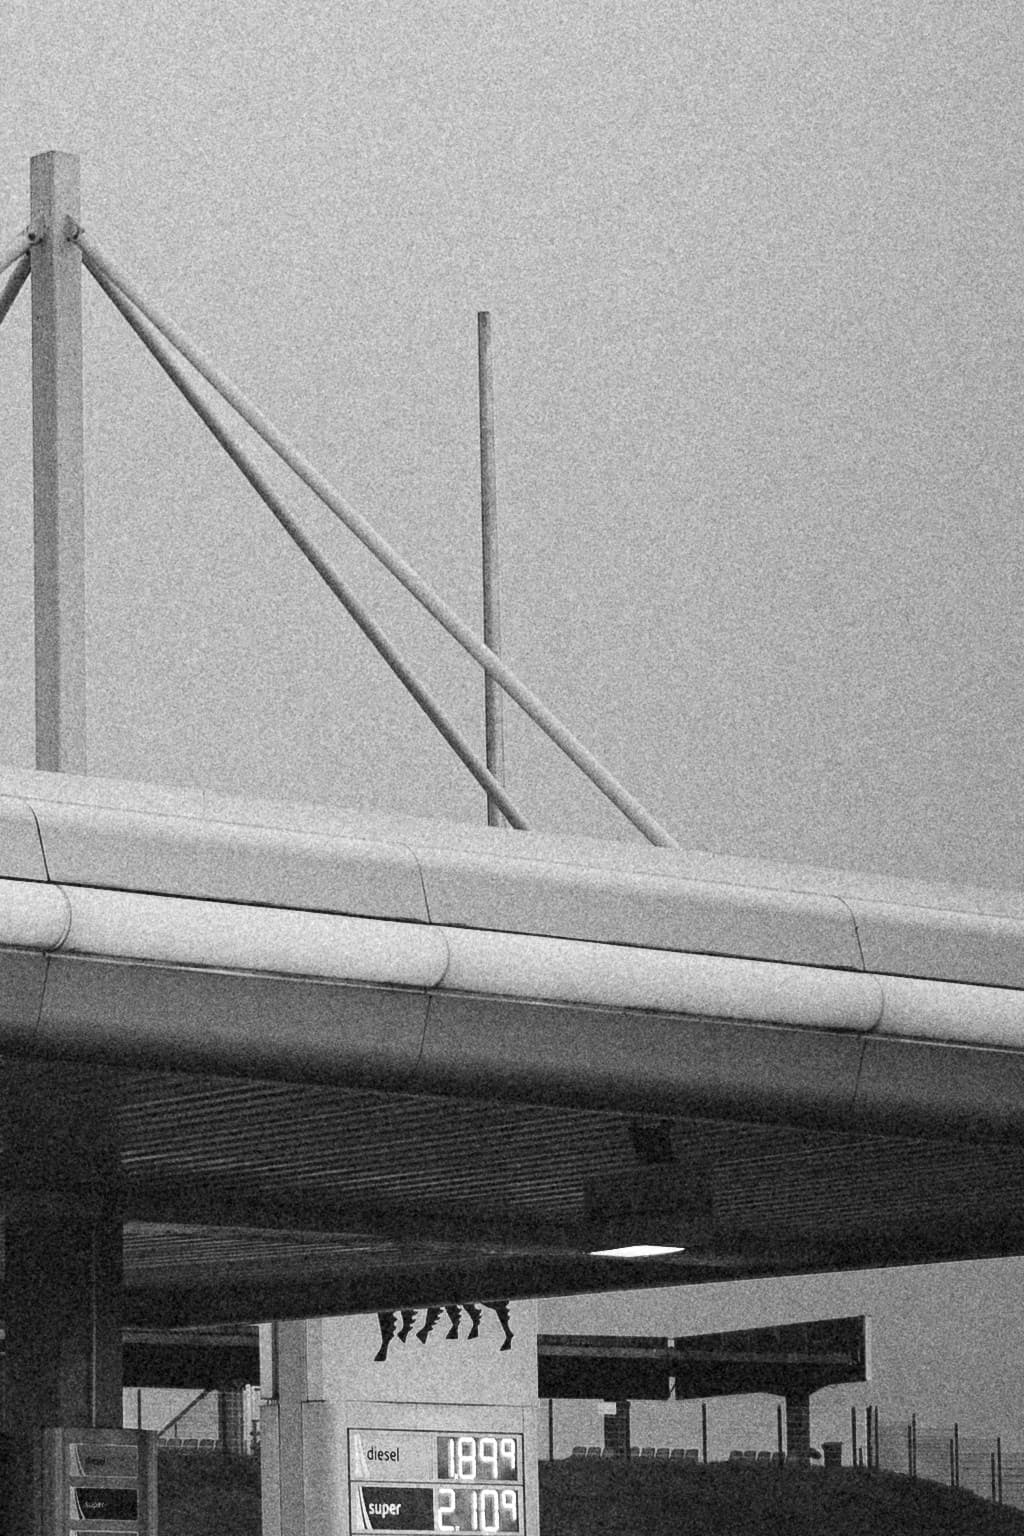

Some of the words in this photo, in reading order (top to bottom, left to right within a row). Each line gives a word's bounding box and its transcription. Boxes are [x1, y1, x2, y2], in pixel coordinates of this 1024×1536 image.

[367, 1447, 400, 1462] diesel
[447, 1436, 516, 1480] 1.899
[368, 1502, 401, 1519] super
[437, 1488, 517, 1533] 2.109
